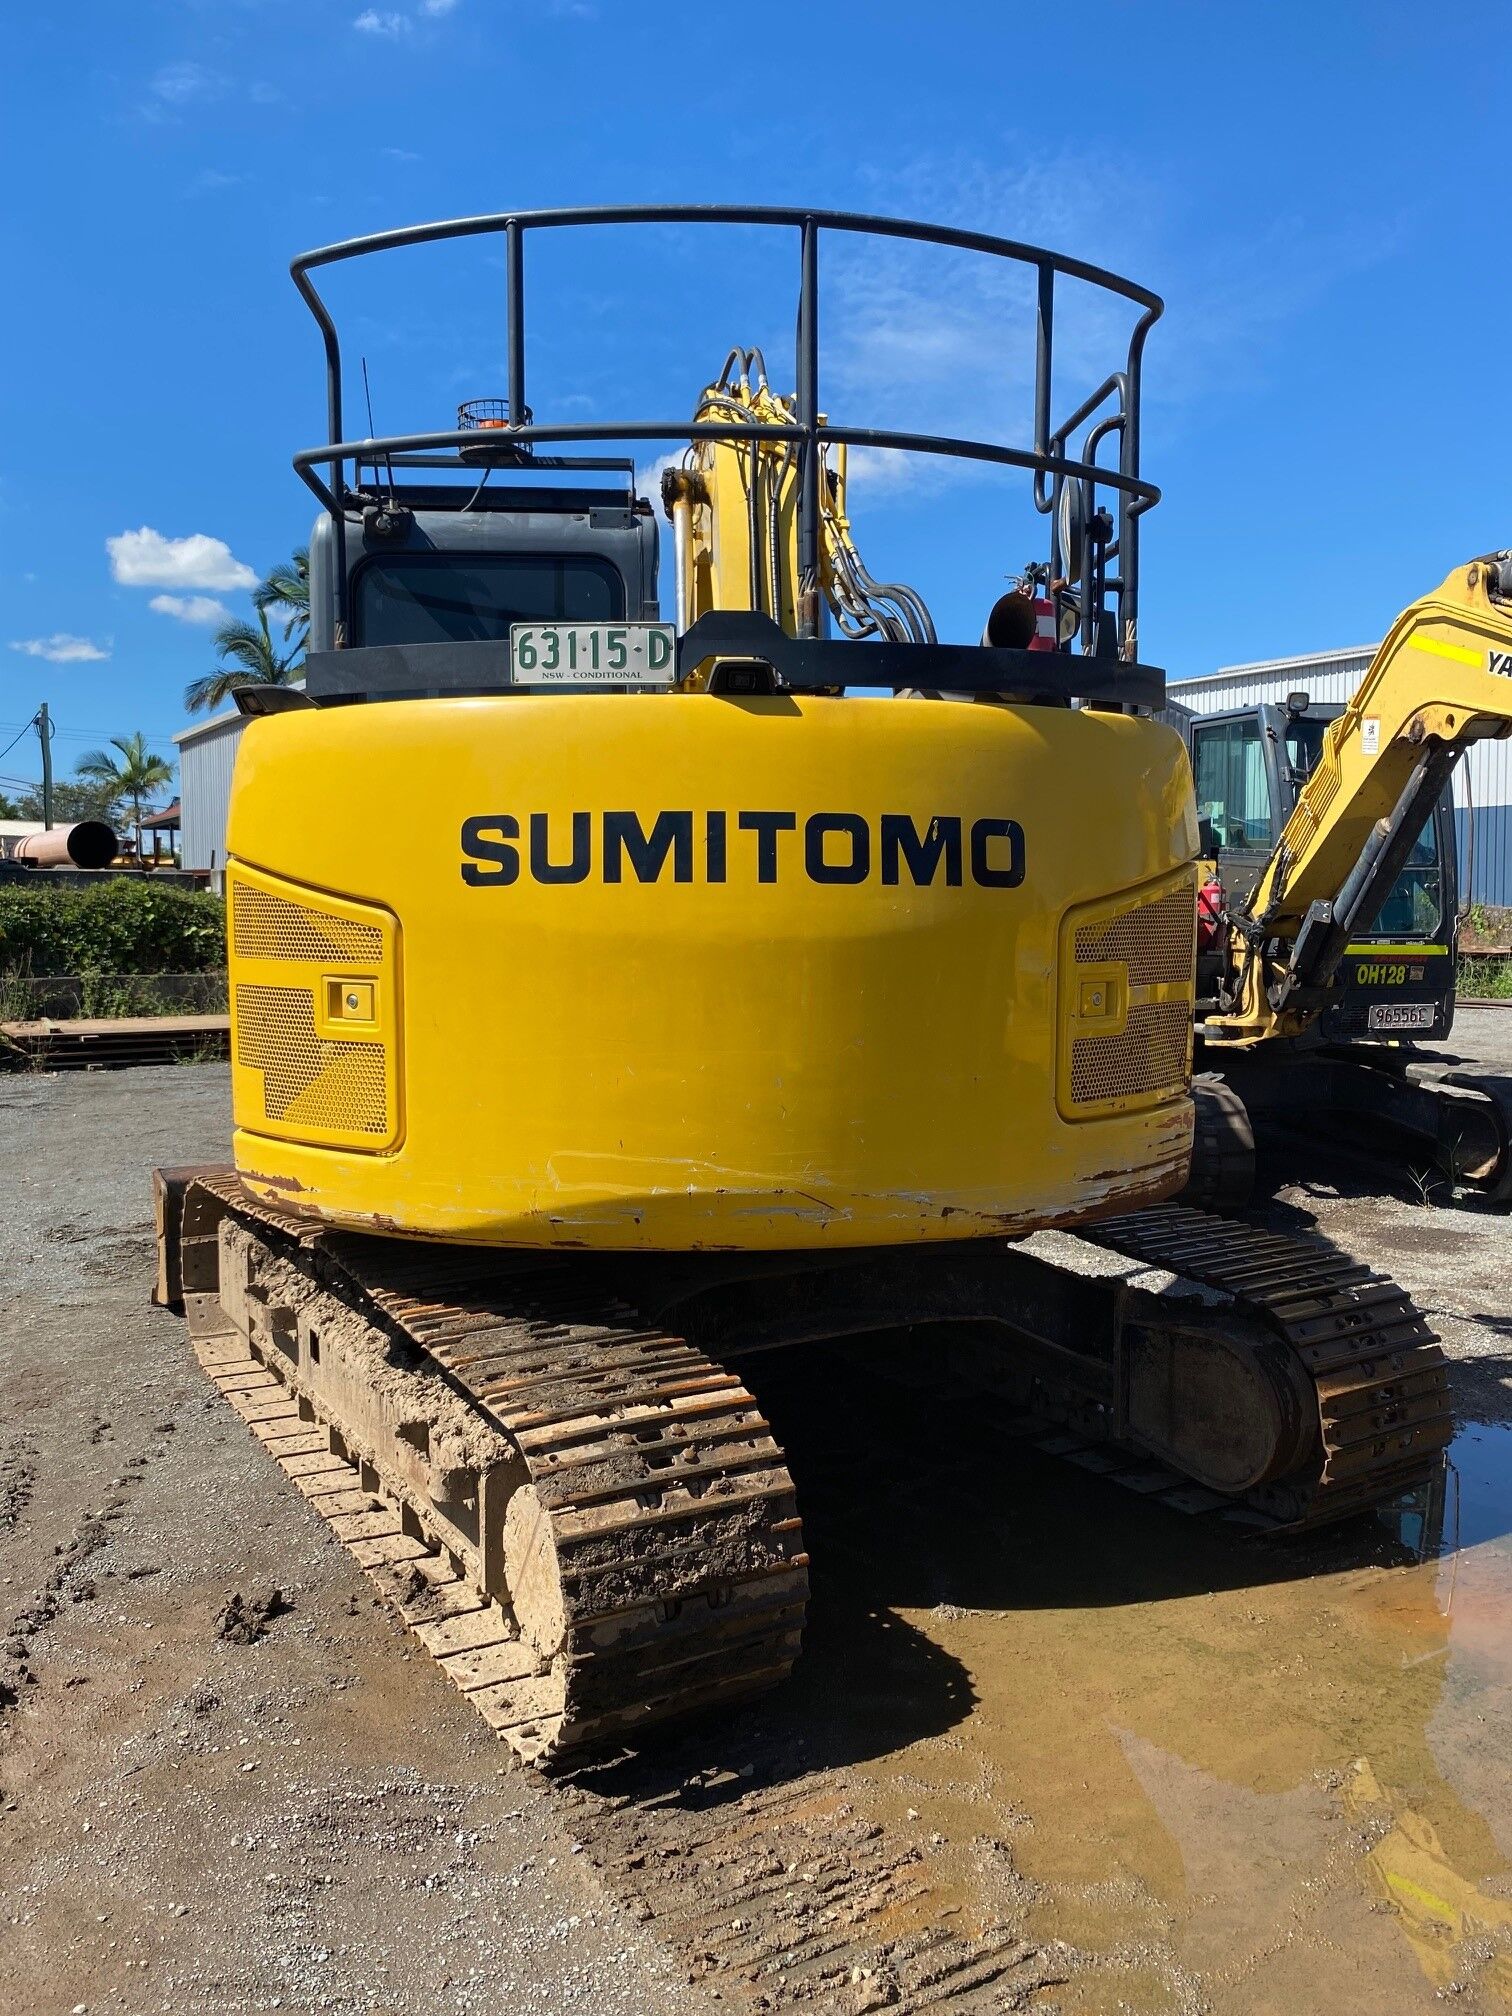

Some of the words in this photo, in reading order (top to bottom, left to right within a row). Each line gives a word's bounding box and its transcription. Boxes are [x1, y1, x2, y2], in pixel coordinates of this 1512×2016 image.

[573, 671, 643, 679] CONDITIONAL
[461, 810, 1025, 888] SUMITOMO
[1357, 964, 1406, 985] OH128
